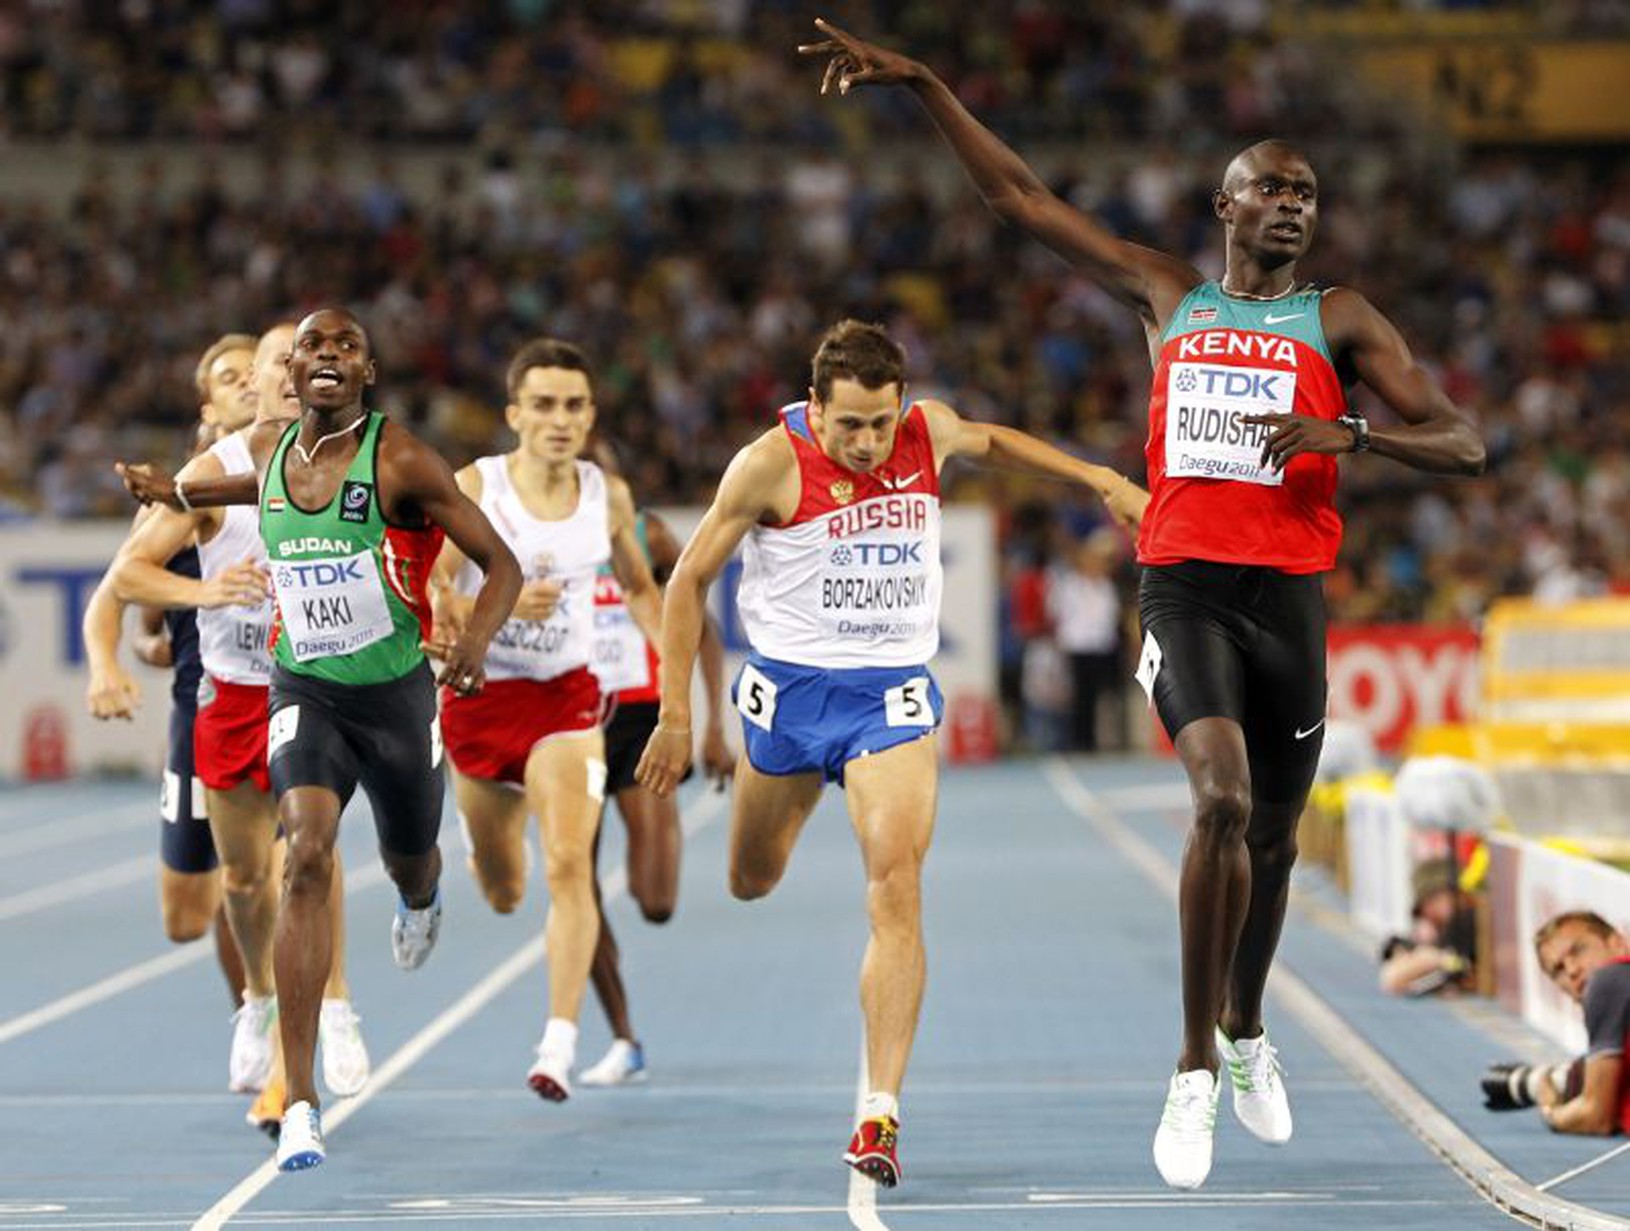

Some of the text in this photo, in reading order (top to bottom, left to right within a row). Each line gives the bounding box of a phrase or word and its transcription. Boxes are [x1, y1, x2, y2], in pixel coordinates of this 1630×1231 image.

[1178, 332, 1297, 367] KENYA
[1199, 369, 1279, 400] TDK
[828, 499, 926, 539] RUSSIA
[278, 537, 352, 556] SUDAN
[853, 541, 922, 565] TDK
[292, 558, 364, 588] TDK
[302, 595, 354, 631] KAKI
[838, 620, 890, 637] Daegu
[296, 636, 347, 656] Daegu
[748, 682, 764, 716] 5
[902, 686, 922, 718] 5
